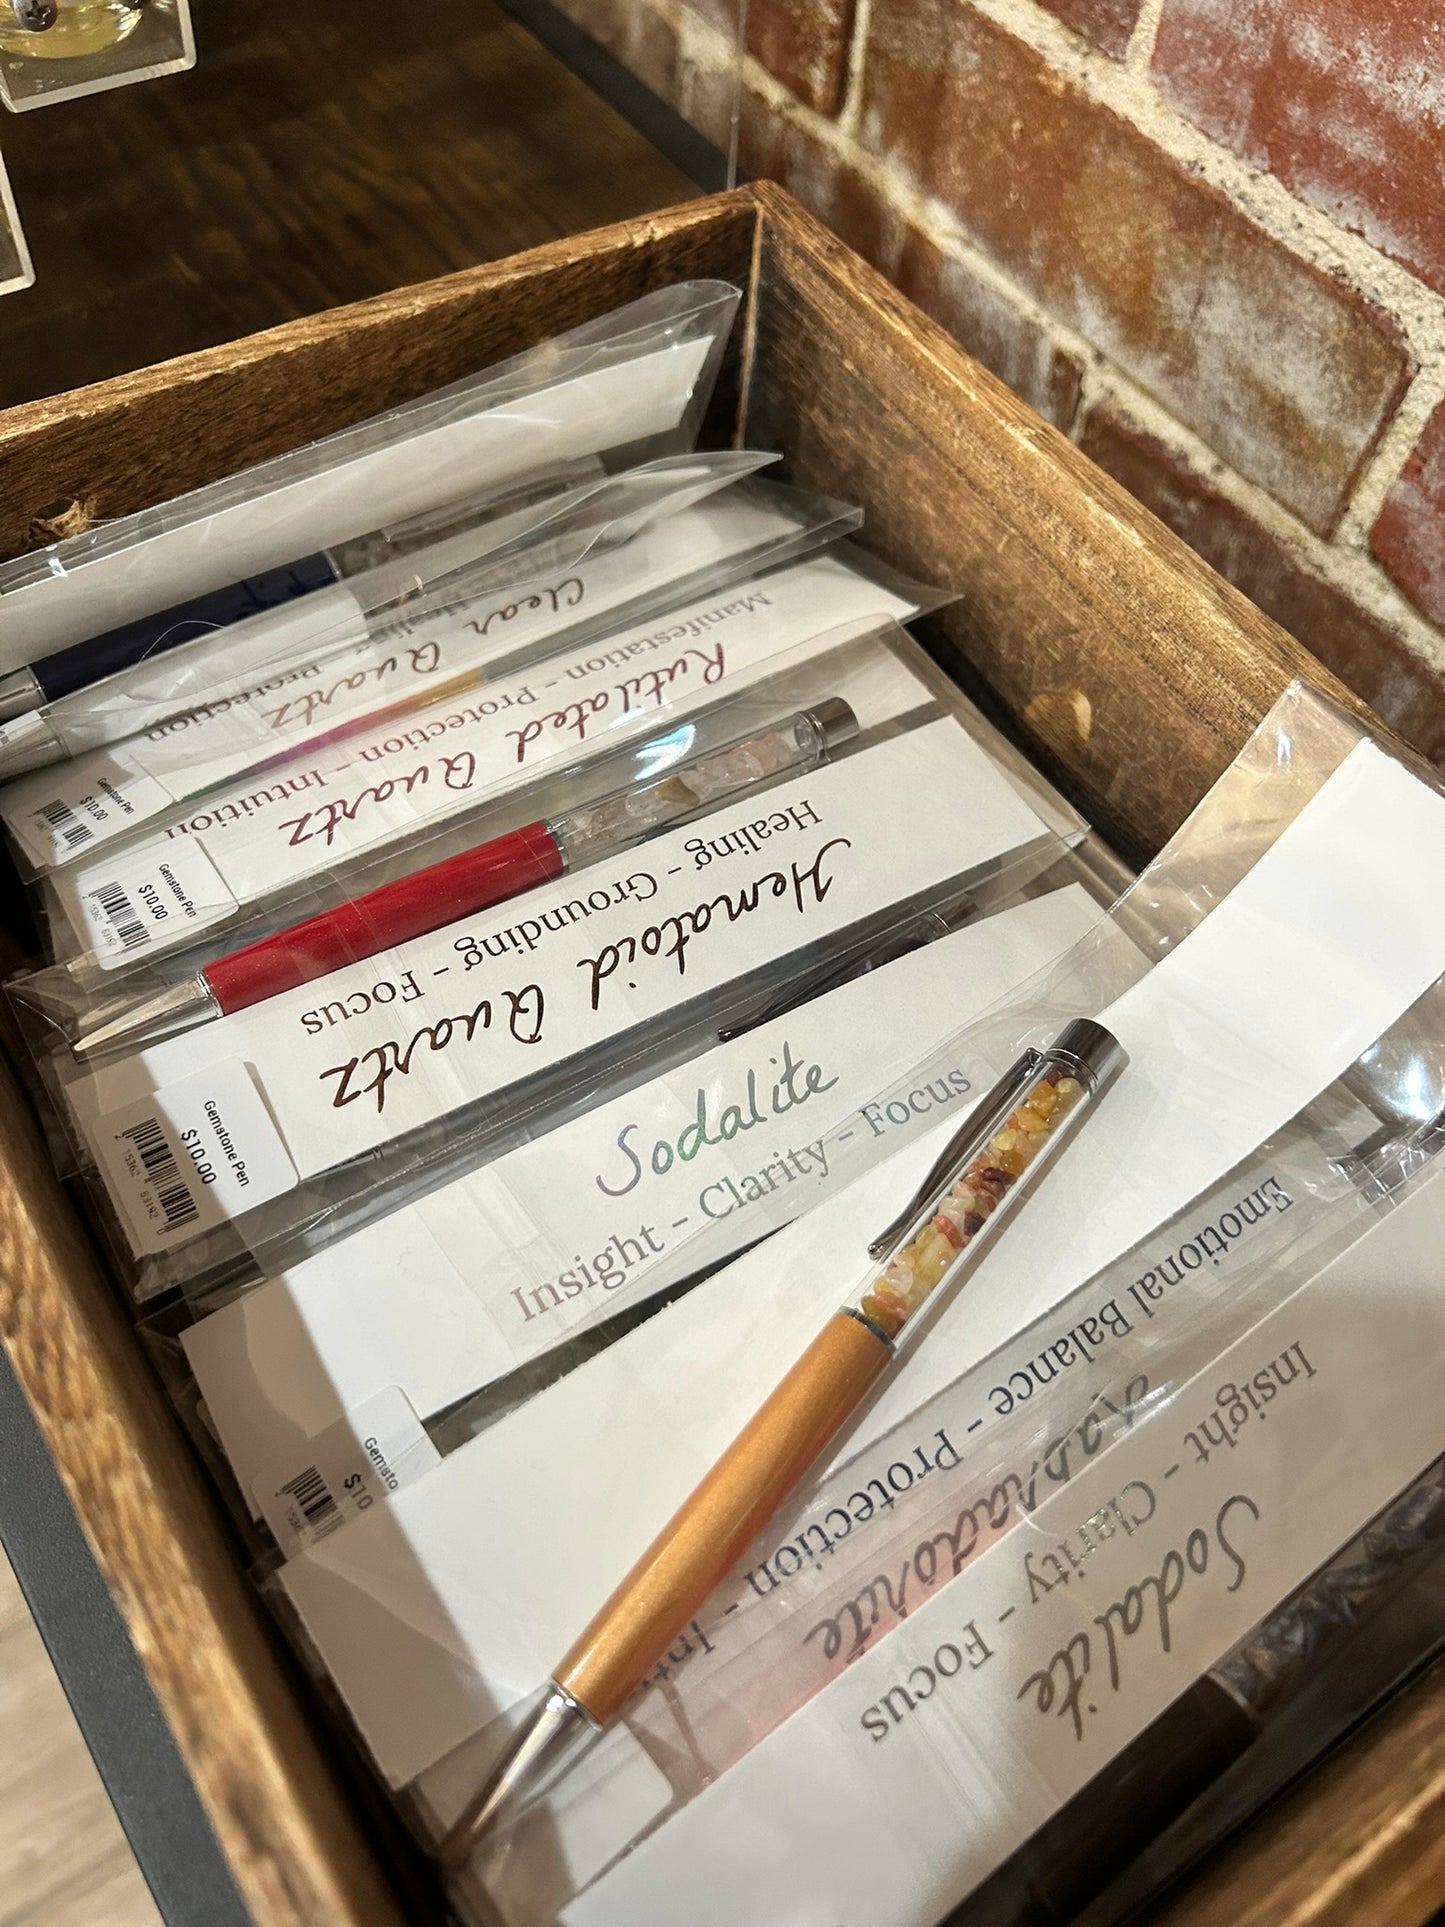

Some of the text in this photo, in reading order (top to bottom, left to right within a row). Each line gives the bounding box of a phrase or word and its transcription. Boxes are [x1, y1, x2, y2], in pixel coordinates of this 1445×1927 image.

[464, 577, 585, 635] Clear
[565, 592, 774, 680] Manifestation
[261, 641, 441, 729] Quartz
[359, 685, 540, 763] Protection
[278, 642, 726, 847] Rutilated Quartz
[80, 796, 109, 821] $10.00
[97, 777, 135, 815] Gemstone Pen
[164, 768, 329, 840] Intuition
[684, 800, 823, 870] Healing
[138, 884, 169, 921] $10.00
[158, 863, 198, 919] Gemstone Pen
[454, 872, 658, 972] Grounding
[300, 970, 426, 1035] Focus
[319, 838, 852, 1113] Hematoid Quartz
[181, 1128, 218, 1185] $10.00
[203, 1100, 251, 1188] Gemstone Pen
[596, 1040, 840, 1197] Sodalite
[510, 1223, 666, 1323] Insight
[699, 1135, 830, 1221] Clarity
[858, 1067, 972, 1139] Focus
[1127, 1175, 1295, 1319] Emotional
[988, 1299, 1135, 1416] Balance
[1184, 1340, 1318, 1464] Insight
[344, 1473, 374, 1511] $10
[364, 1437, 400, 1491] Gemsto
[744, 1429, 965, 1599] Protection
[802, 1373, 1150, 1664] Labradorite
[1023, 1480, 1157, 1606] Clarity
[1017, 1494, 1260, 1742] Sodalite
[860, 1620, 996, 1743] Focus
